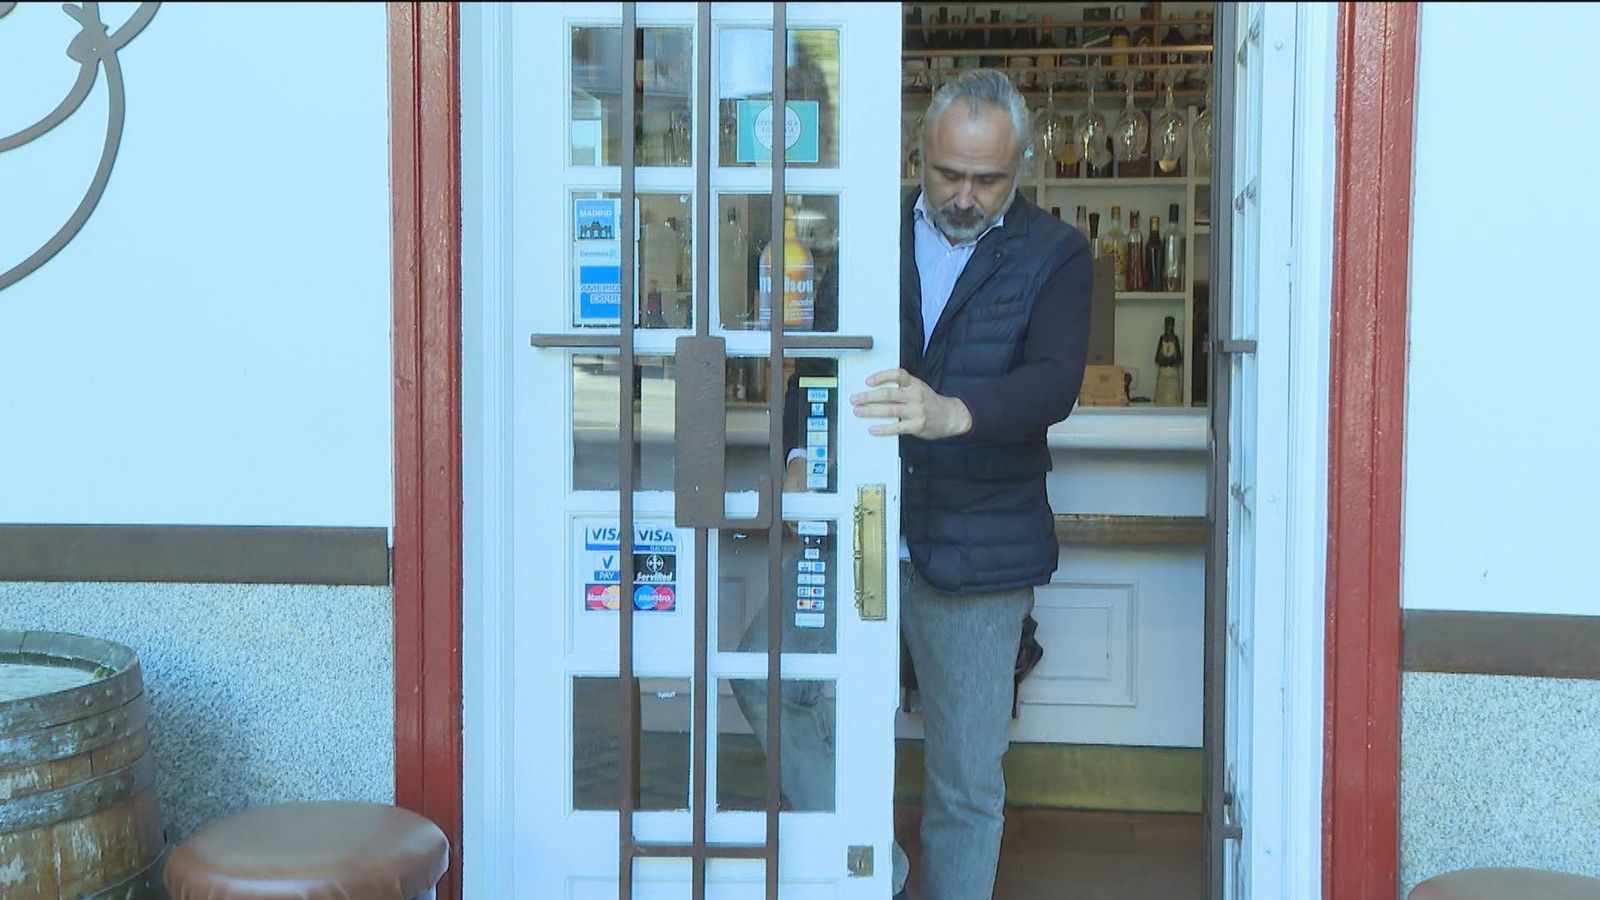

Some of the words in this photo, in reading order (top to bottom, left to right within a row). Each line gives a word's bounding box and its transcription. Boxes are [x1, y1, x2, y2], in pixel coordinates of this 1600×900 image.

[580, 209, 612, 217] MADRID
[592, 528, 620, 541] VIS
[639, 529, 673, 542] VISA
[603, 555, 613, 569] V
[600, 572, 614, 580] PAY
[637, 572, 673, 582] ServiRed
